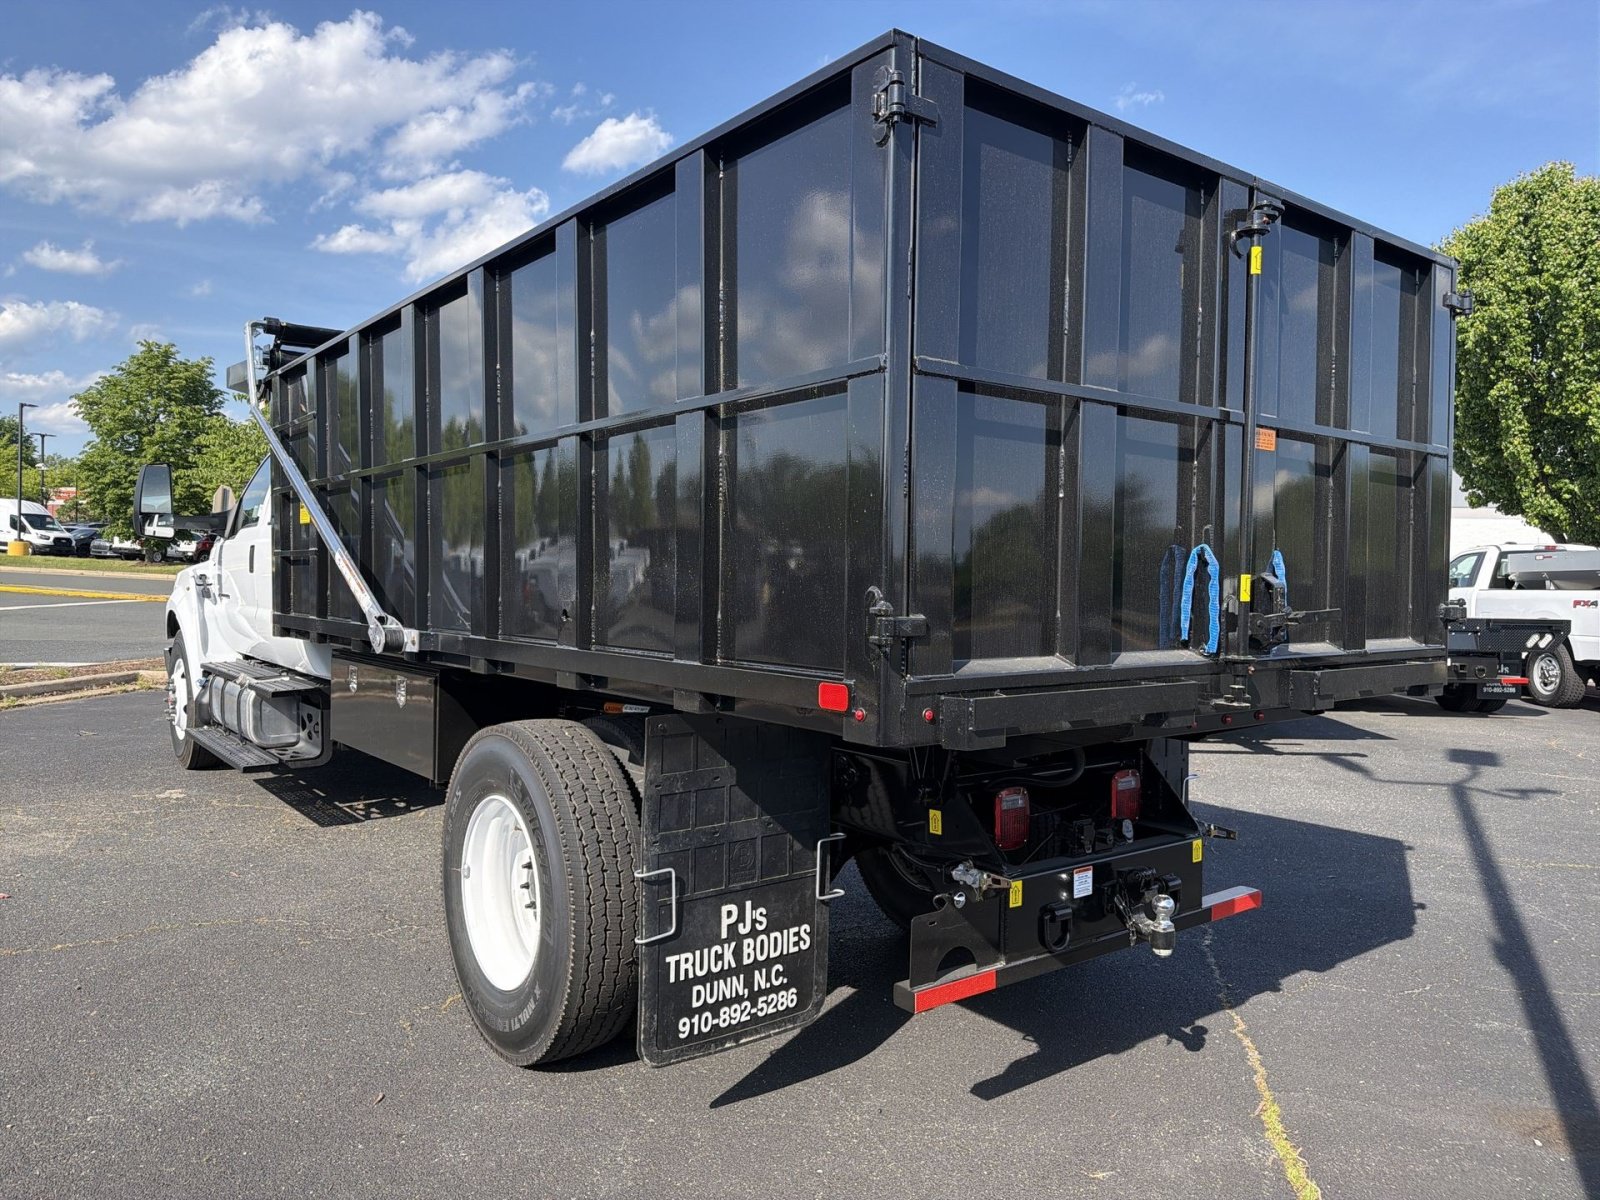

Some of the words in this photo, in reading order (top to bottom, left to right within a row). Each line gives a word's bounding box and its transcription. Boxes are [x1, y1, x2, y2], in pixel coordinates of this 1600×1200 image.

[1573, 600, 1598, 608] FX4
[665, 941, 737, 984] TRUCK
[742, 923, 811, 966] BODIES
[691, 974, 749, 1009] DUNN,
[754, 963, 788, 992] N.C.
[510, 996, 536, 1032] MULTI
[678, 988, 798, 1039] 910-892-5286
